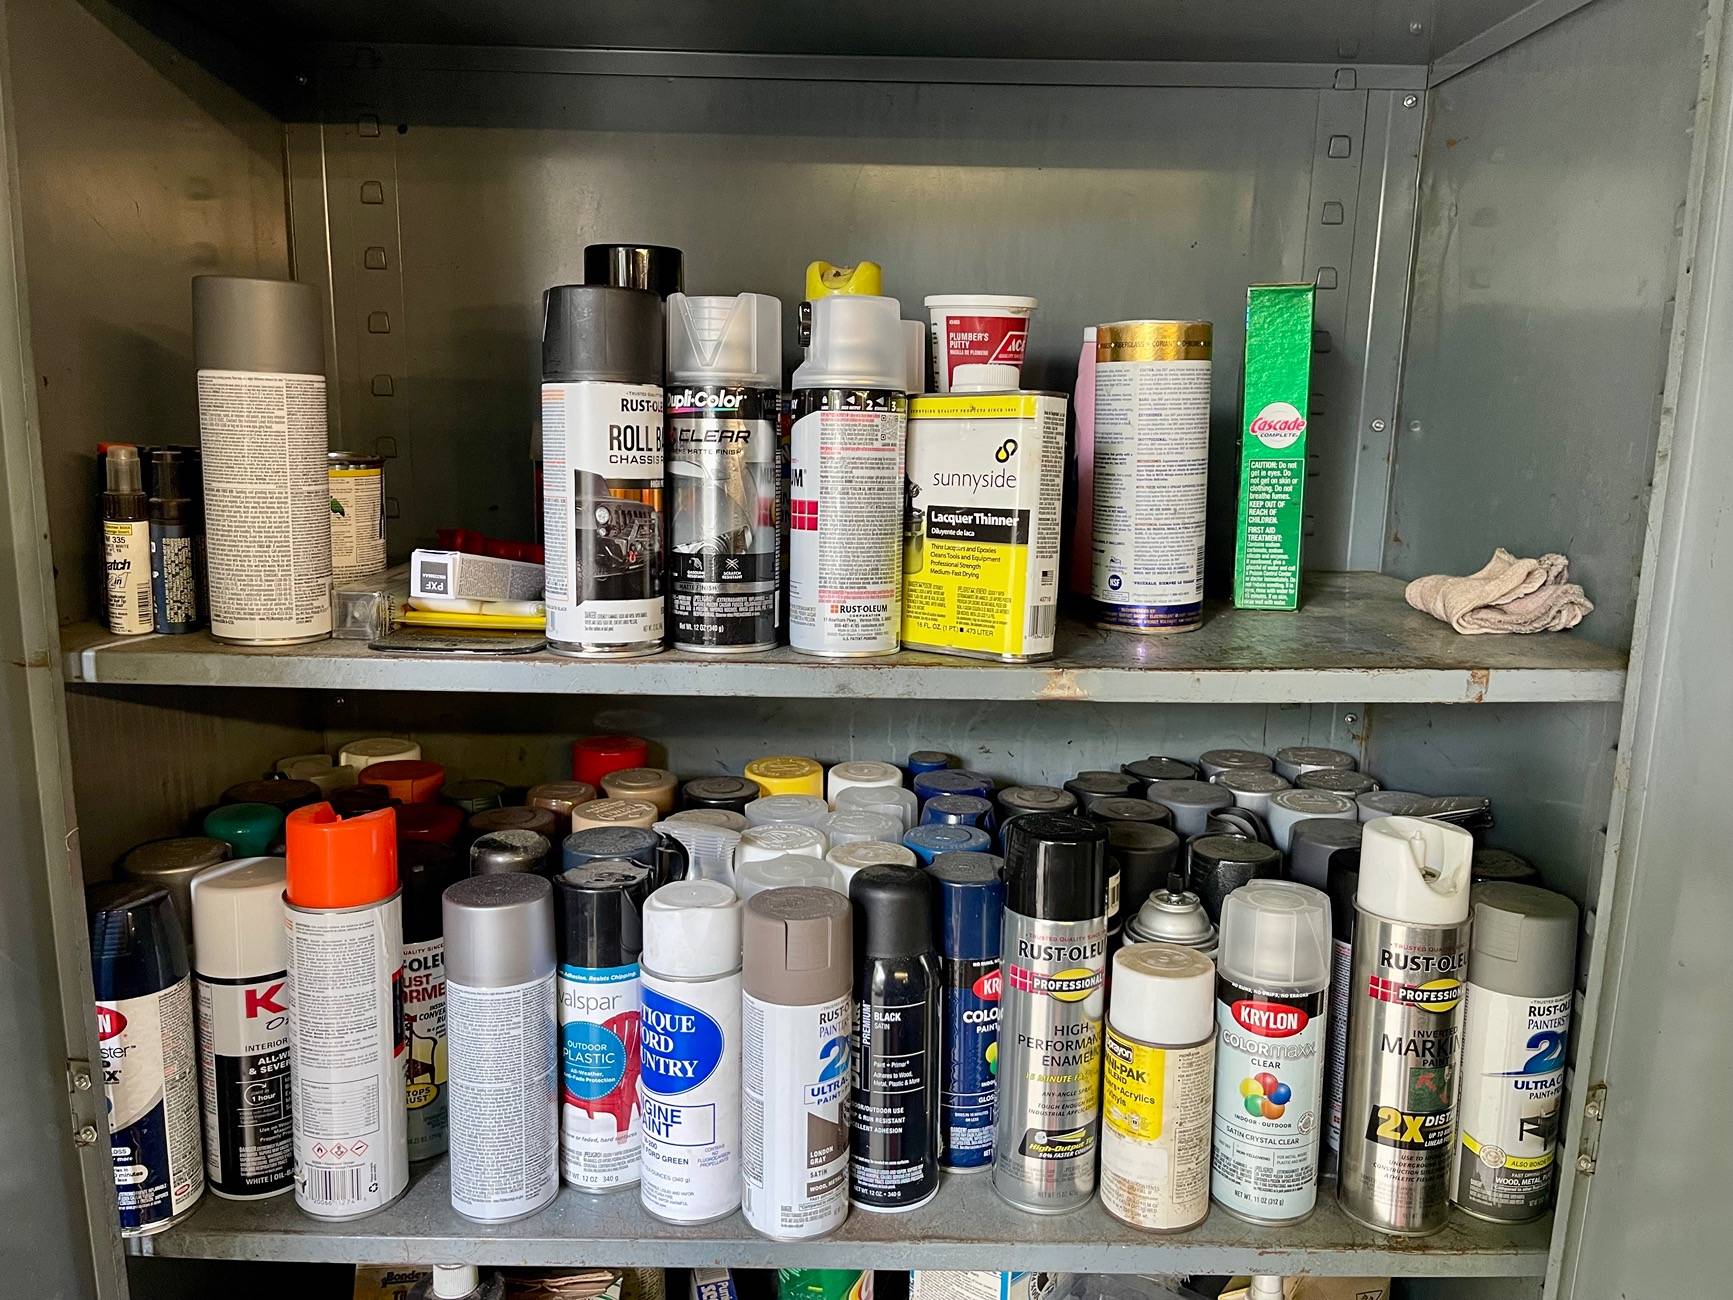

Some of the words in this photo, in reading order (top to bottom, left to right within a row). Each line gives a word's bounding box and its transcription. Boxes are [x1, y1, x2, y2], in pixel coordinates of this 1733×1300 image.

[949, 332, 989, 342] PLUMBER'S
[949, 340, 970, 349] PUTTY
[866, 400, 874, 411] 2
[891, 401, 897, 412] 3
[1250, 417, 1306, 434] Cascade
[609, 424, 653, 452] ROLL
[678, 429, 752, 444] CLEAR
[609, 454, 660, 465] CHASSIS
[1250, 461, 1278, 469] CAUTION:
[1278, 461, 1287, 469] Do
[1287, 461, 1297, 469] not
[1250, 469, 1260, 478] get
[1267, 470, 1282, 478] eyes.
[1283, 469, 1291, 477] Do
[932, 467, 1017, 495] sunnyside
[1260, 477, 1270, 486] get
[1249, 485, 1273, 493] clothing.
[931, 510, 974, 526] Lacquer
[973, 513, 1019, 528] Thinner
[930, 527, 956, 537] Diluyente
[956, 529, 963, 537] de
[963, 529, 975, 537] laca
[1247, 526, 1265, 534] FIRST
[1264, 526, 1276, 534] AID
[112, 536, 126, 544] 335
[976, 547, 997, 555] Epoxies
[930, 552, 947, 560] Cleans
[947, 553, 960, 561] Tools
[971, 555, 1001, 563] Equipment
[930, 559, 959, 568] Professional
[959, 562, 981, 571] Strength
[961, 571, 980, 580] Drying
[1109, 578, 1121, 587] NSF
[839, 604, 888, 614] RUST-OLEUM
[1033, 973, 1102, 990] PROFESSIONAL
[874, 1011, 901, 1022] BLACK
[1240, 1005, 1298, 1030] KRYLON
[862, 1003, 871, 1046] PREMIUM
[874, 1022, 890, 1031] SATIN
[1054, 1022, 1089, 1036] HIGH
[245, 1037, 288, 1052] INTERIOR
[567, 1040, 608, 1051] OUTDOOR
[563, 1048, 616, 1065] PLASTIC
[1250, 1058, 1281, 1069] CLEAR
[248, 1067, 257, 1076] &
[873, 1071, 893, 1079] Adheres
[1037, 1074, 1072, 1083] MINUTE
[888, 1080, 904, 1088] Plastic
[258, 1093, 276, 1102] hour
[1041, 1090, 1055, 1098] ANY
[1037, 1102, 1061, 1110] TOUGH
[1028, 1109, 1065, 1117] INDUSTRIAL
[1234, 1113, 1257, 1125] INDOOR
[1261, 1121, 1292, 1129] OUTDOOR
[1376, 1105, 1426, 1143] 2X
[873, 1126, 903, 1134] ADHESION
[1226, 1125, 1244, 1138] SATIN
[1245, 1133, 1277, 1145] CRYSTAL
[1424, 1137, 1444, 1147] LINEAR
[810, 1145, 834, 1158] LONDON
[1053, 1151, 1074, 1159] FASTER
[661, 1155, 689, 1165] GREEN
[810, 1155, 827, 1165] GRAY
[1511, 1160, 1528, 1168] ALSO
[810, 1168, 828, 1179] SATIN
[245, 1176, 269, 1185] WHITE
[589, 1175, 598, 1183] OZ
[602, 1175, 614, 1183] 340
[1234, 1189, 1243, 1199] NET
[1253, 1194, 1260, 1203] 11
[1260, 1197, 1267, 1205] OZ
